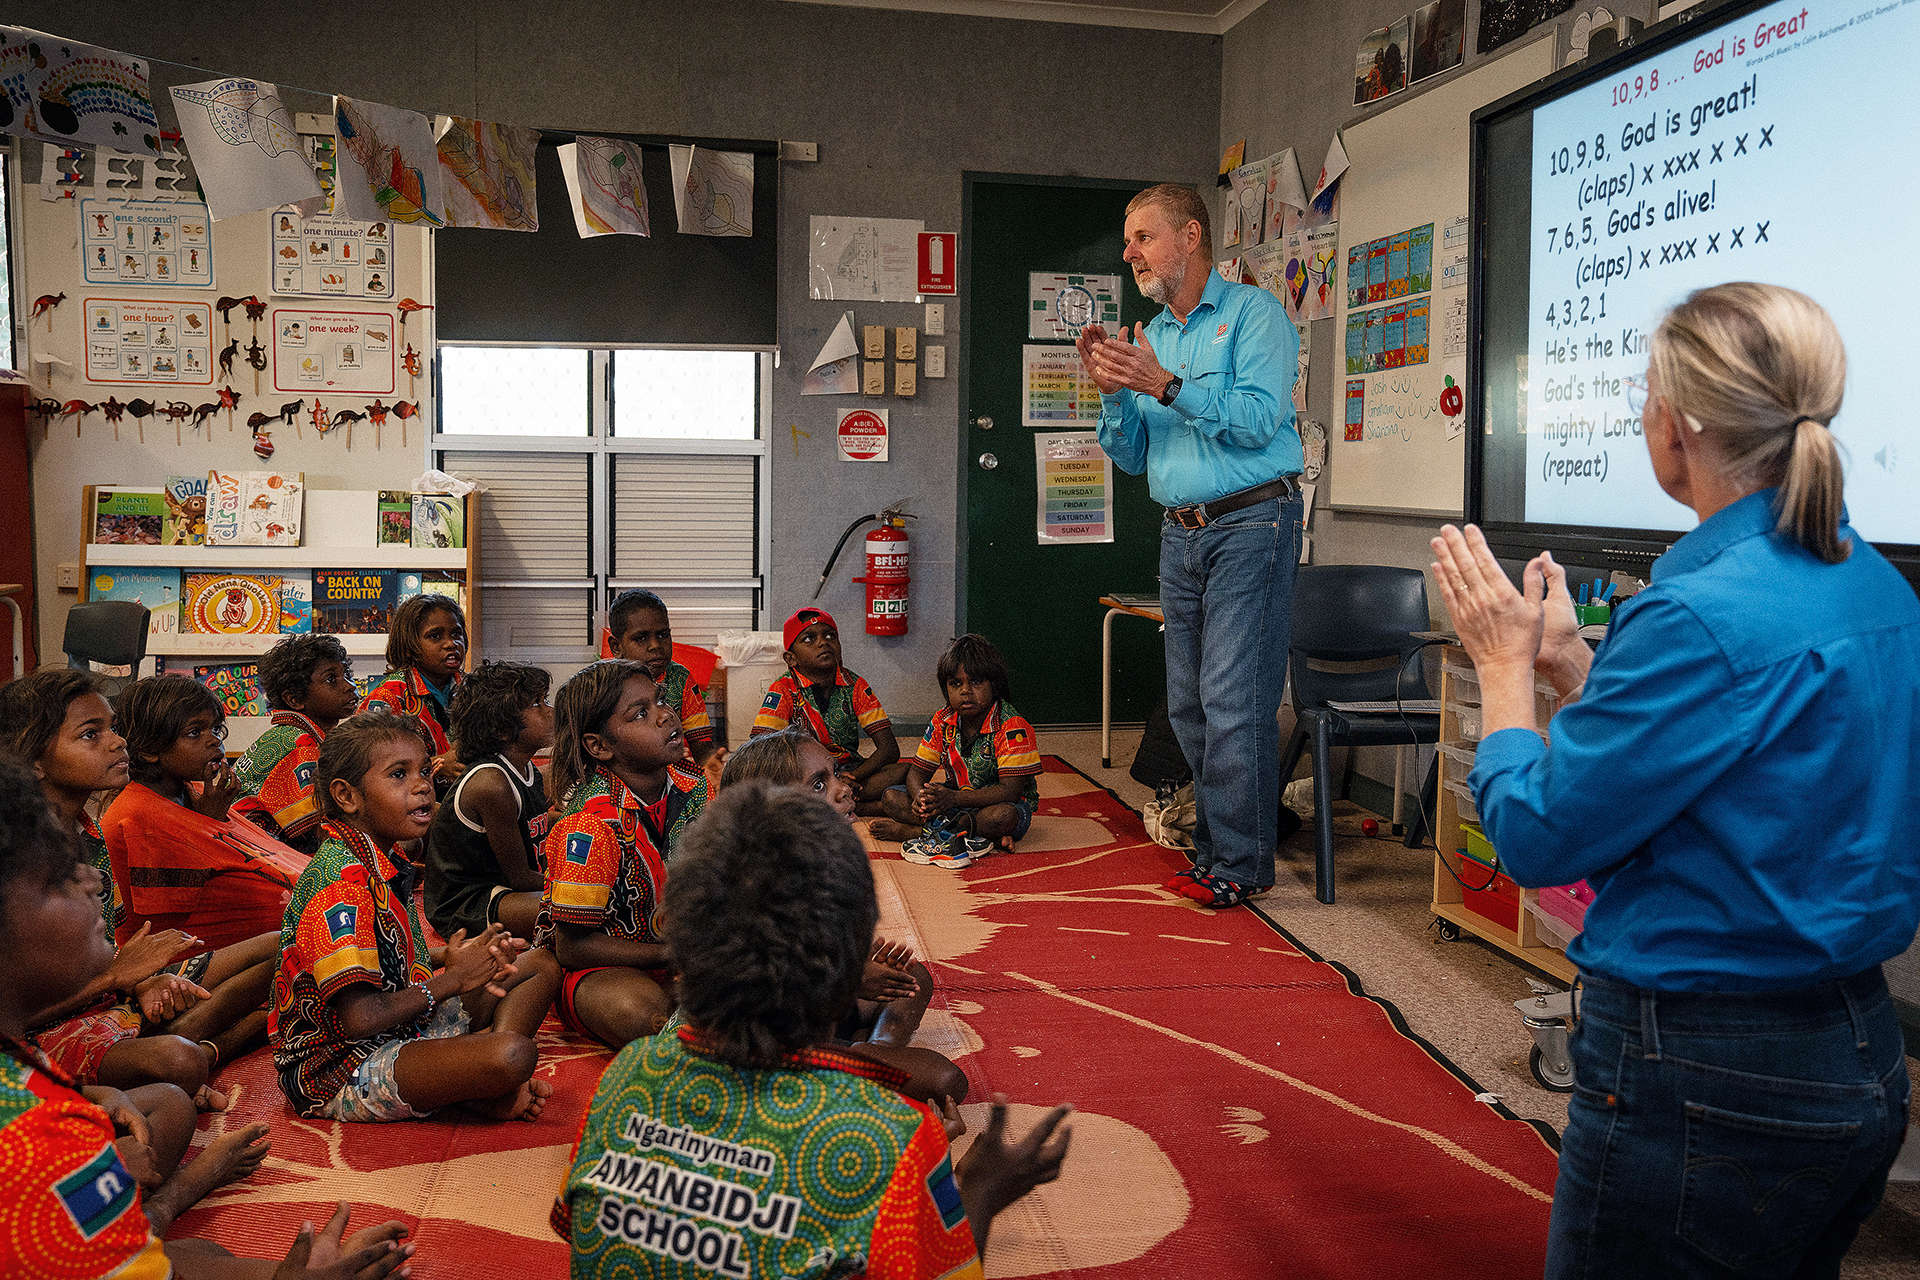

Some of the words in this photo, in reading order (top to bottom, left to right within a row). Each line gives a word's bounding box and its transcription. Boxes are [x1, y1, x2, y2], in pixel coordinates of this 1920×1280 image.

[1612, 69, 1659, 107] 10,9,8
[1693, 40, 1724, 73] God
[1732, 36, 1746, 58] is
[1753, 7, 1808, 50] Great
[1745, 56, 1764, 67] Words
[1764, 51, 1775, 61] and
[1776, 45, 1793, 56] Music
[1793, 42, 1801, 51] by
[1550, 133, 1611, 177] 10,9,8,
[1621, 111, 1657, 152] God
[1665, 108, 1681, 136] is
[1689, 73, 1757, 137] great!
[1578, 162, 1635, 211] (claps)
[115, 215, 134, 223] one
[136, 214, 178, 224] second?
[1547, 216, 1598, 255] 7,6,5,
[1608, 199, 1655, 238] God's
[1664, 179, 1716, 222] alive!
[303, 228, 321, 236] one
[324, 227, 364, 237] minute?
[1576, 245, 1632, 290] (claps)
[123, 313, 142, 322] one
[144, 313, 175, 323] hour?
[1545, 292, 1606, 331] 4,3,2,1
[329, 324, 360, 333] week?
[1545, 336, 1578, 366] He's
[1585, 332, 1613, 361] the
[1622, 328, 1651, 357] Kin
[1544, 374, 1585, 403] God's
[1593, 371, 1621, 399] the
[1543, 413, 1596, 447] mighty
[1058, 449, 1090, 457] MONDAY
[1053, 475, 1097, 483] WEDNESDAY
[1543, 450, 1609, 486] (repeat)
[115, 496, 149, 505] PLANTS
[1057, 488, 1094, 496] THURSDAY
[206, 507, 214, 521] You
[213, 474, 240, 541] draw
[1056, 514, 1094, 522] SATURDAY
[1061, 526, 1091, 534] SUNDAY
[114, 573, 130, 583] Tim
[131, 573, 162, 584] Minchin
[327, 576, 360, 588] BACK
[363, 576, 382, 588] ON
[201, 591, 213, 605] Old
[213, 580, 238, 594] Nana
[239, 581, 267, 606] Quokka
[327, 588, 383, 600] COUNTRY
[162, 614, 176, 634] UP
[204, 665, 259, 691] COLOUR
[218, 681, 241, 700] AKES
[242, 676, 259, 688] THE
[625, 1114, 773, 1174] Ngarinyman
[589, 1154, 797, 1236] AMANBIDJI
[600, 1199, 746, 1276] SCHOOL
